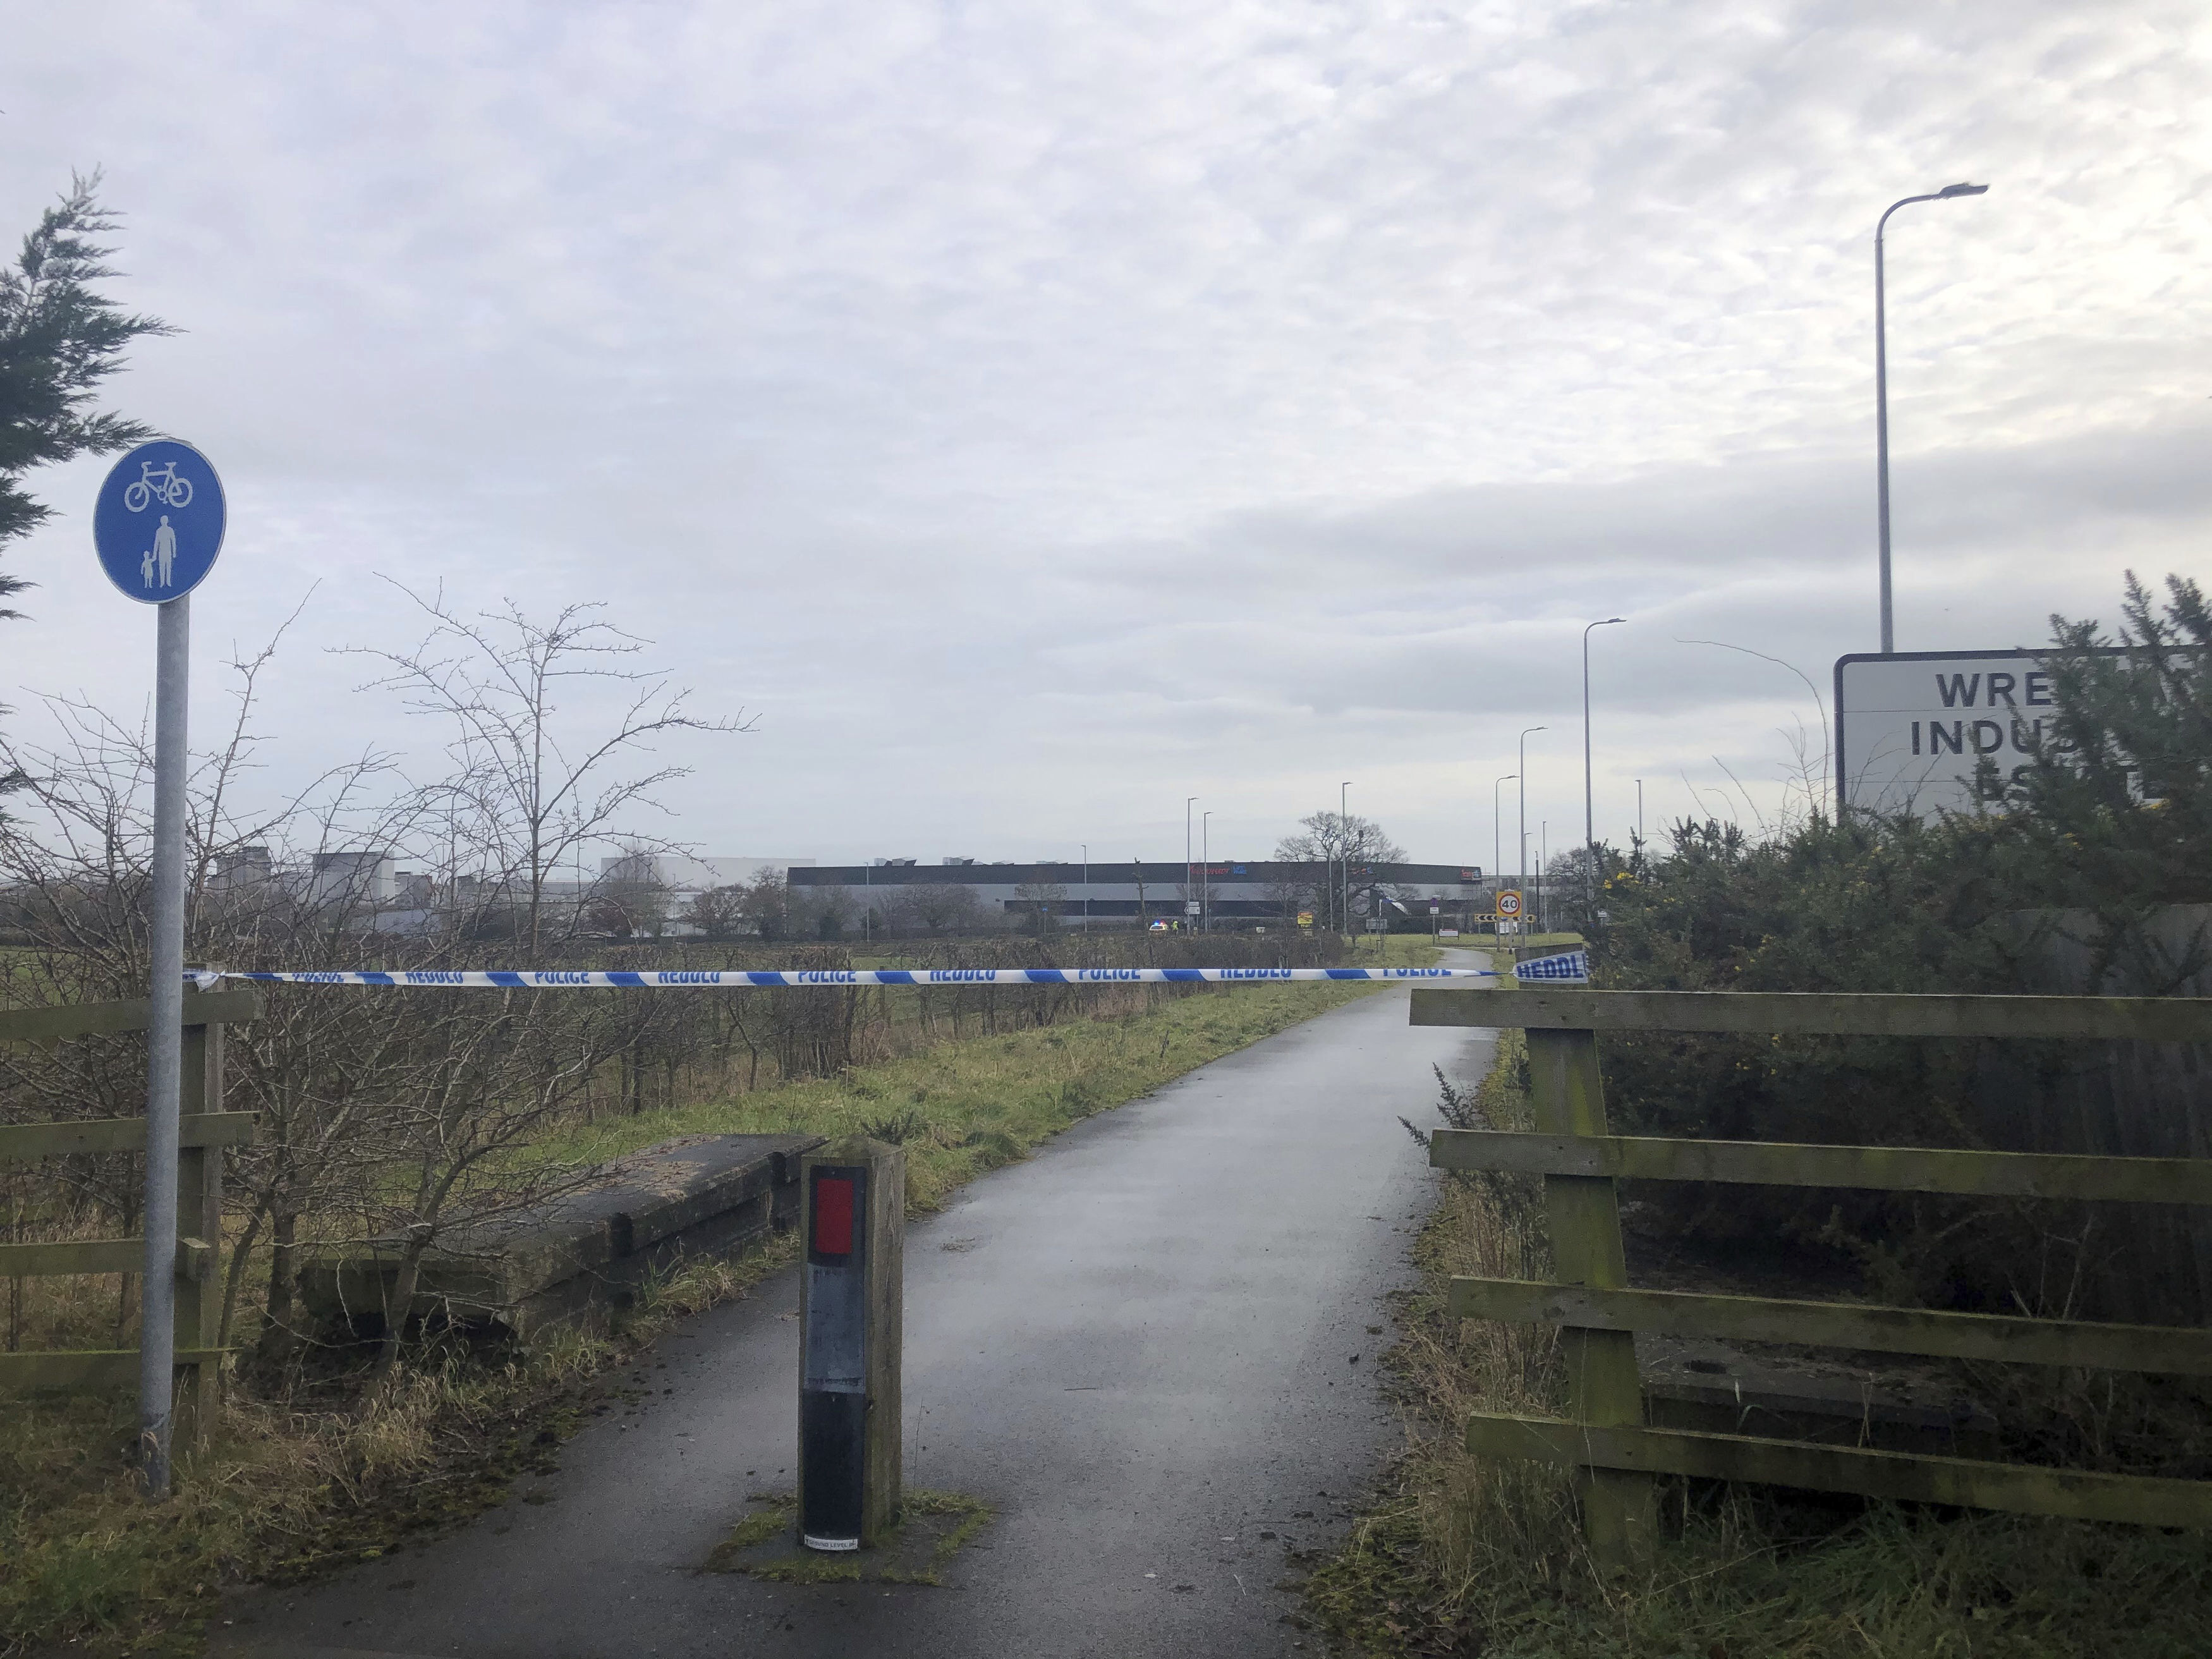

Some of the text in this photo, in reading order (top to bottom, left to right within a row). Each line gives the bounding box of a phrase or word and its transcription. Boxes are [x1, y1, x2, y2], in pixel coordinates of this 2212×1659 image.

[1936, 671, 2052, 708] WRE
[1502, 900, 1517, 908] 40
[534, 971, 590, 985] POLICE
[798, 970, 856, 983] POLICE
[1078, 969, 1141, 980] POLICE
